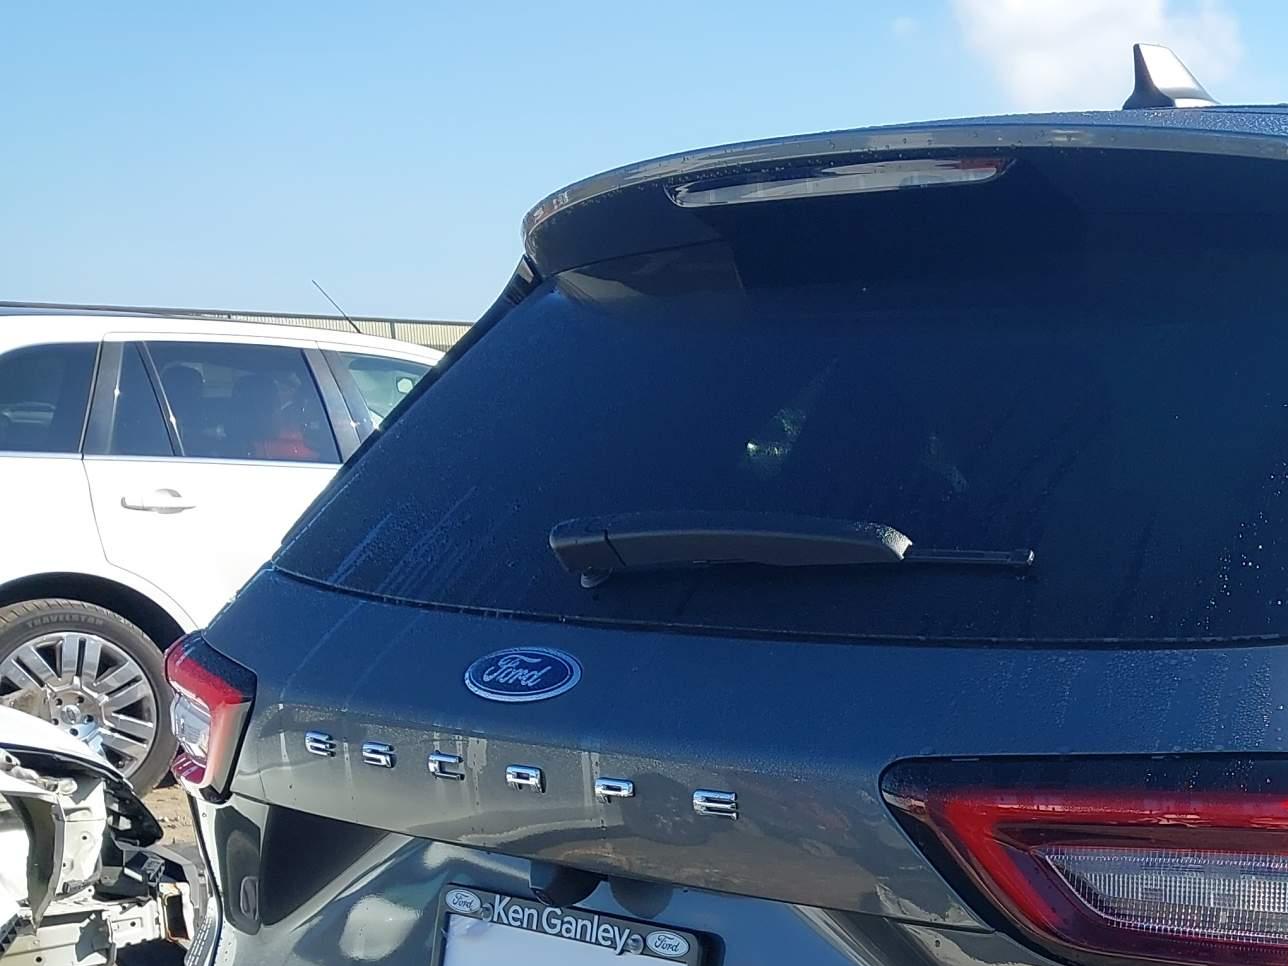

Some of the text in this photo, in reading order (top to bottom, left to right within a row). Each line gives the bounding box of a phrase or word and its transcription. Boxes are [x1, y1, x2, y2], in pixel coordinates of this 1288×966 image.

[304, 730, 739, 821] ESCAPE
[492, 894, 632, 956] Ken Ganley
